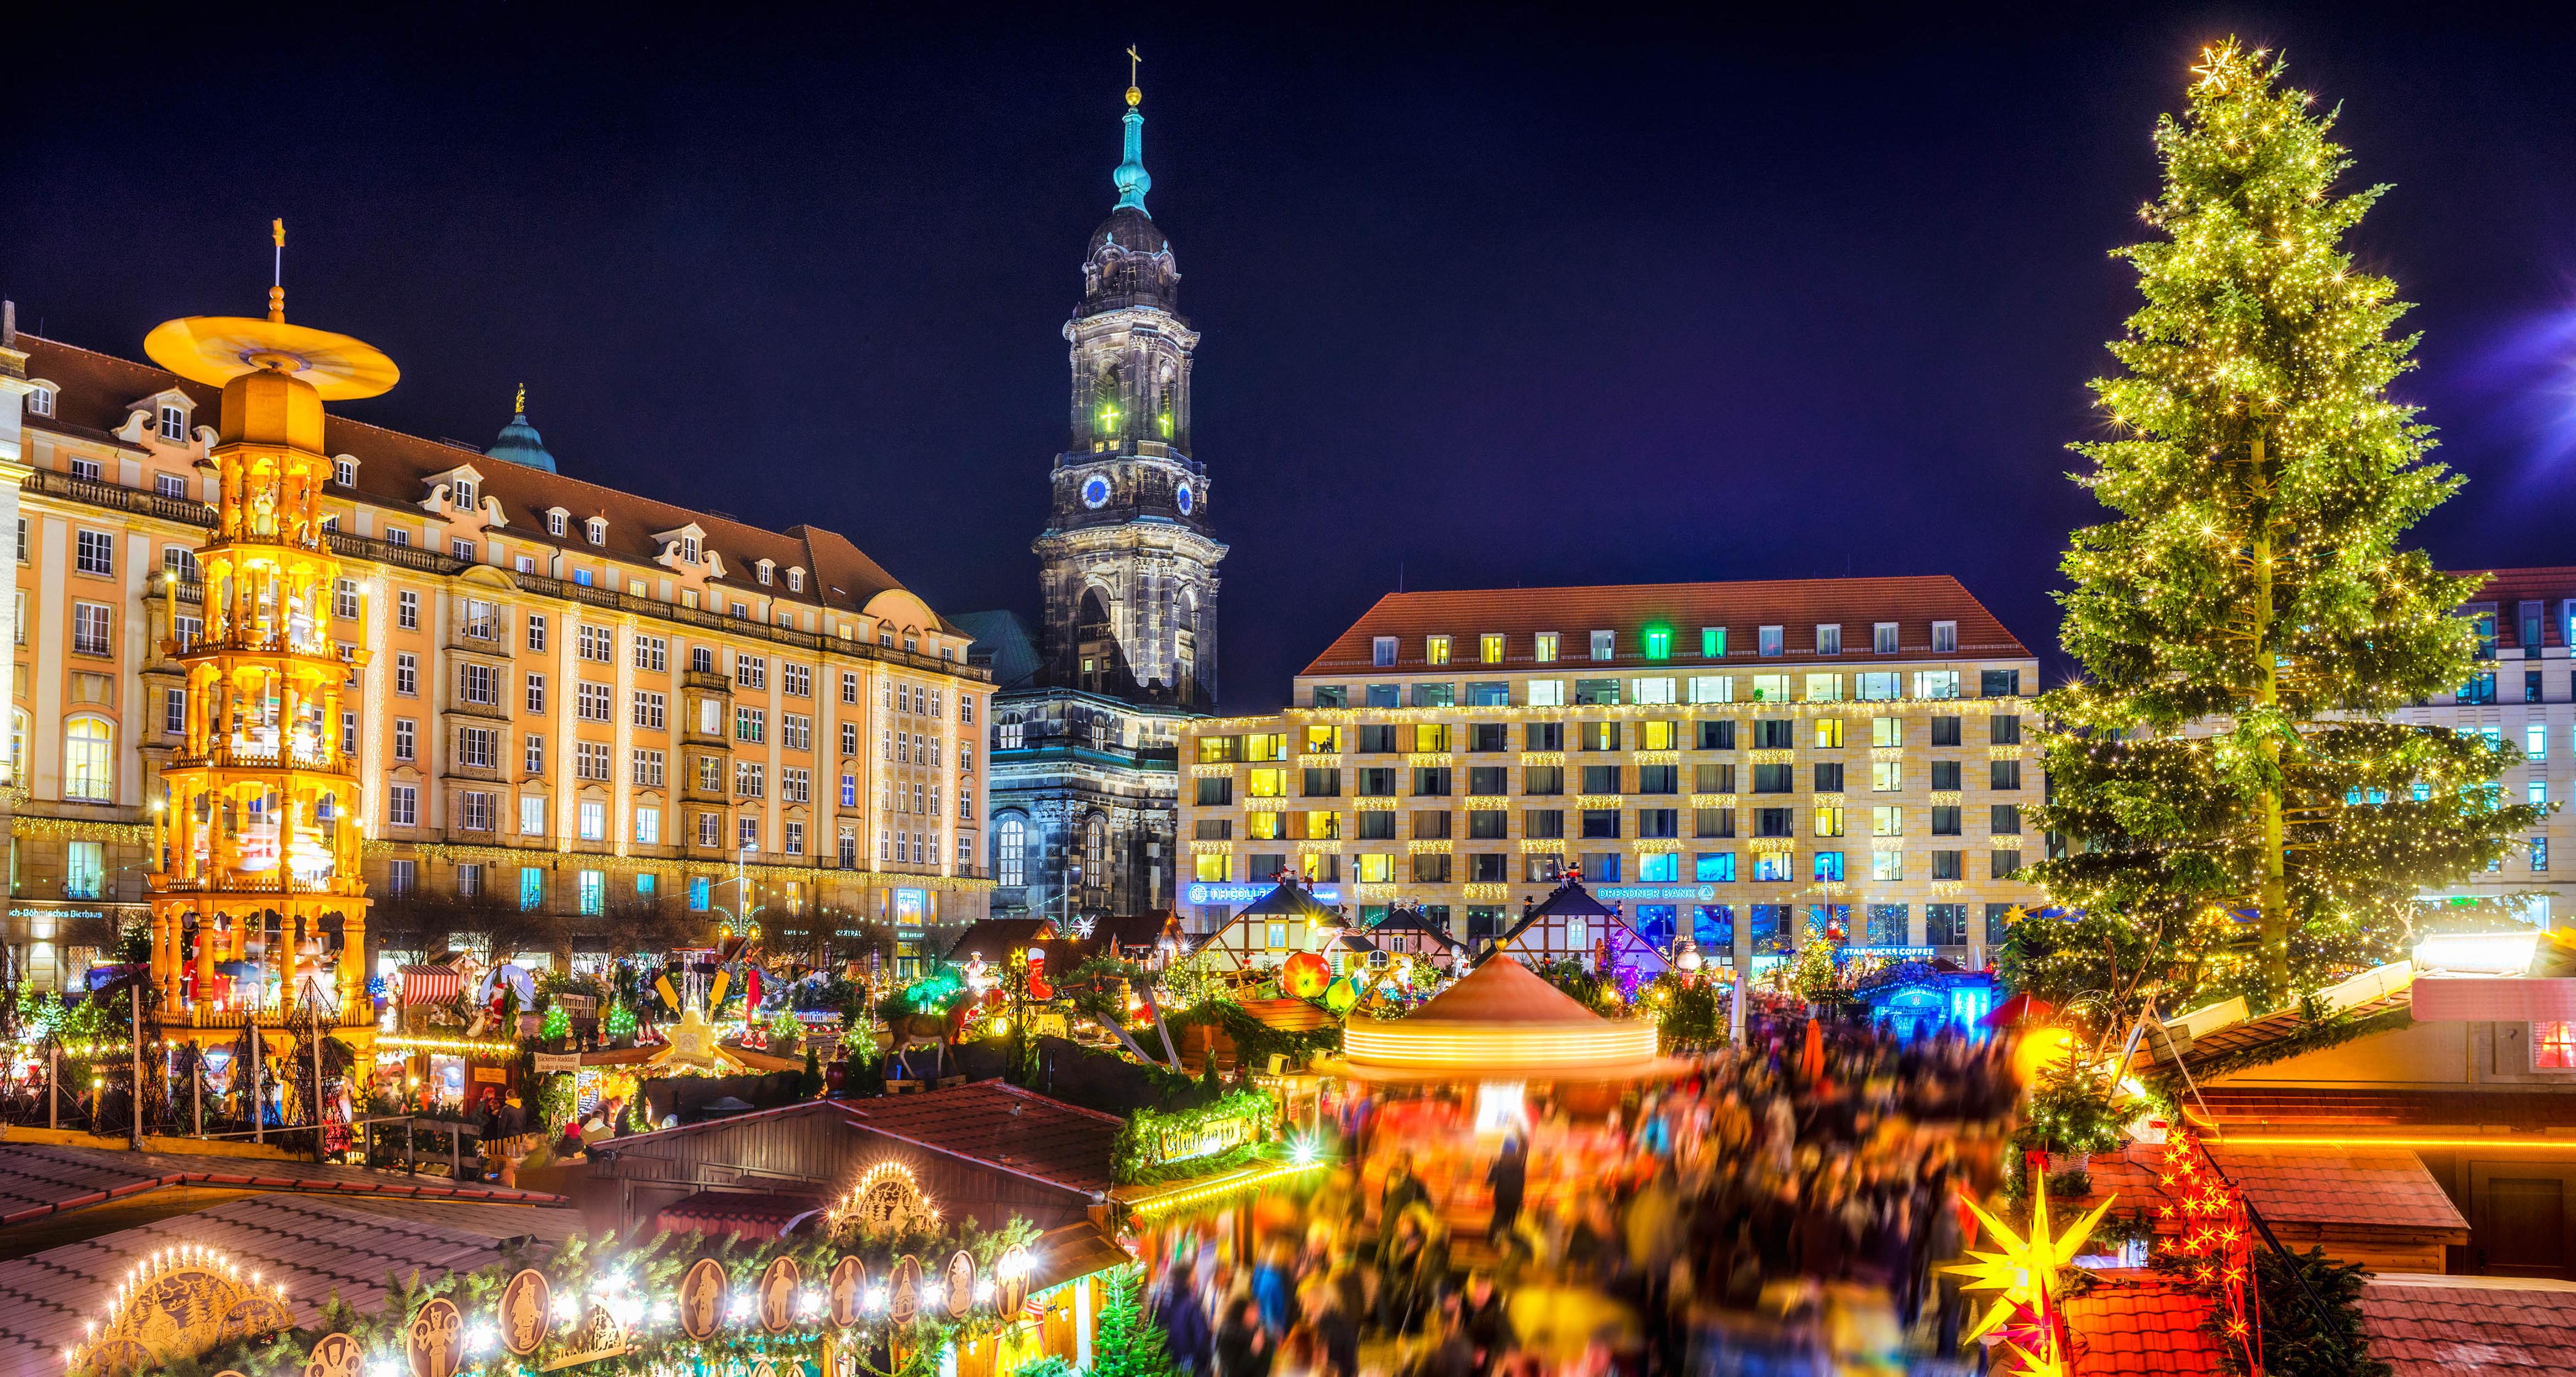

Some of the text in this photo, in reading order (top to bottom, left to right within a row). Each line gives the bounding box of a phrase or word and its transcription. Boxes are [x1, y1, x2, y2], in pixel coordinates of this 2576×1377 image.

[1598, 888, 1696, 898] DRESDNER BANK
[690, 1059, 709, 1067] Raddatz
